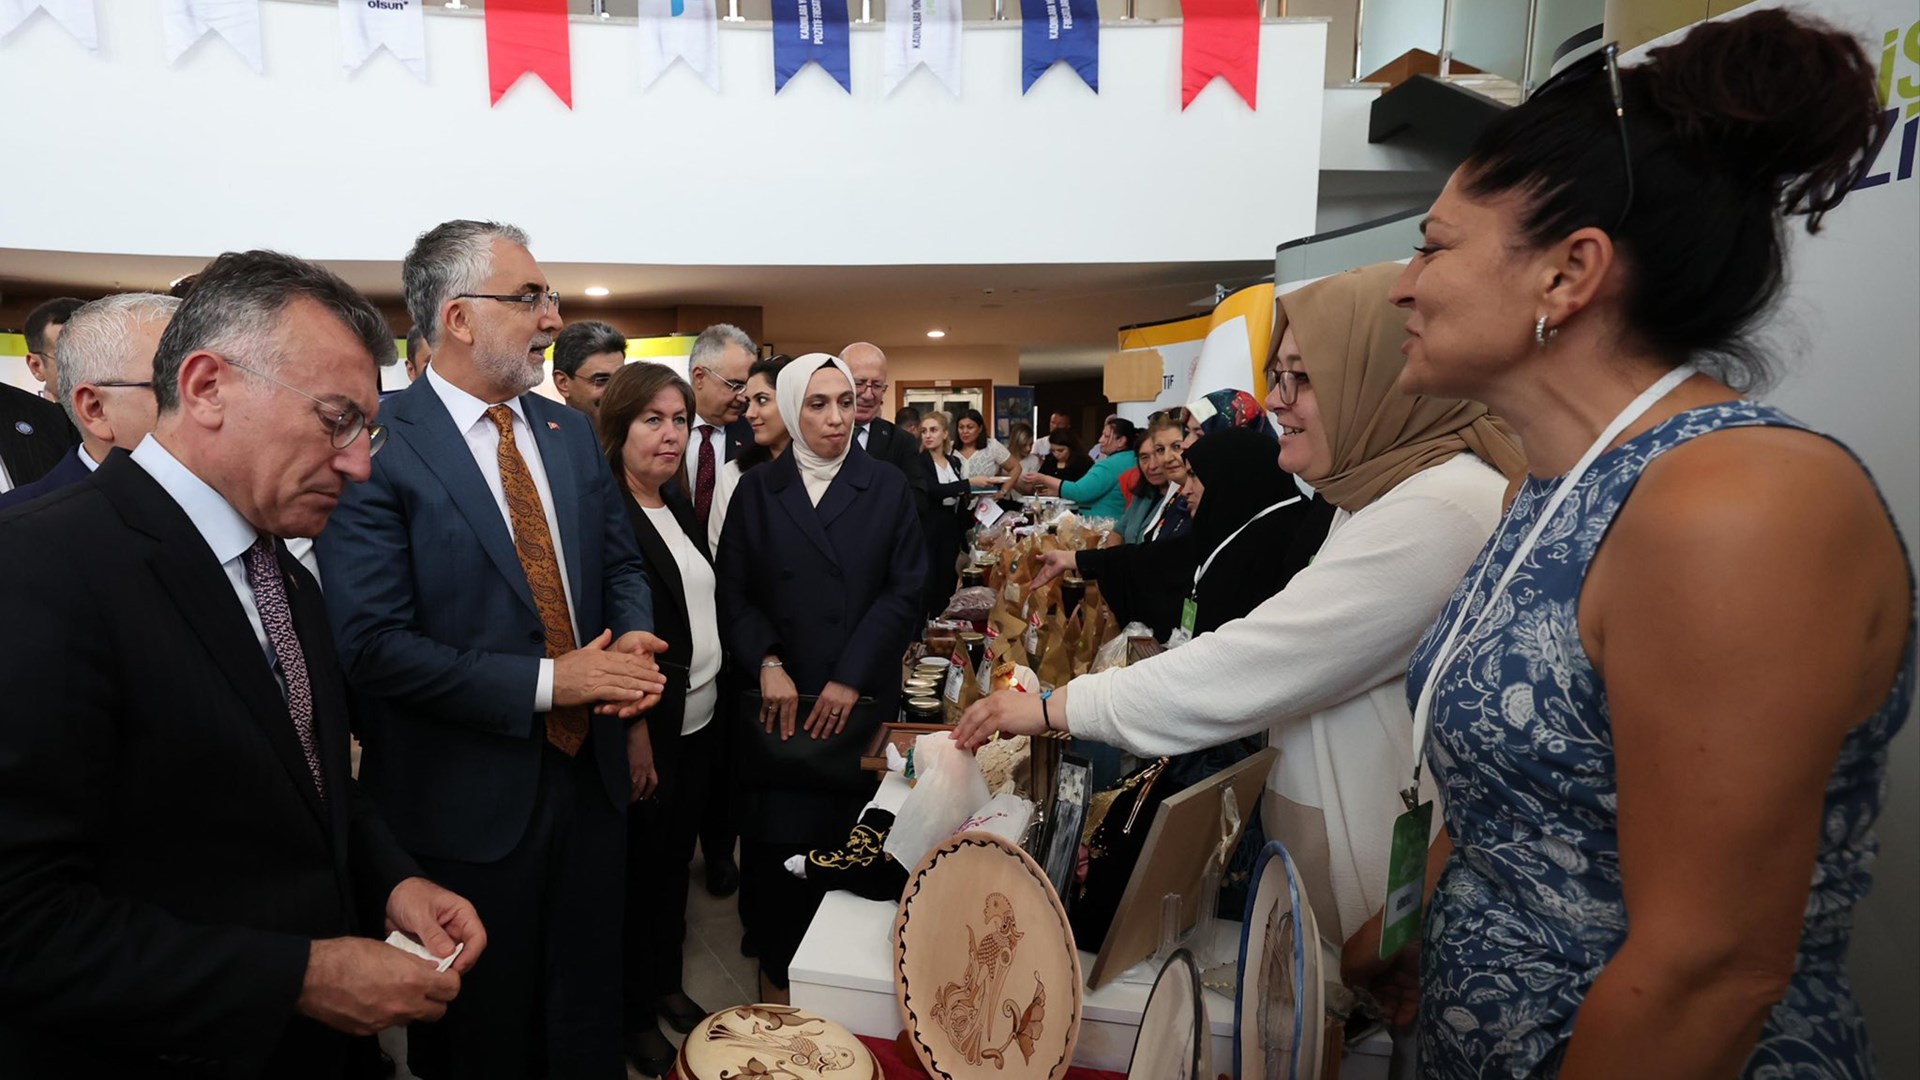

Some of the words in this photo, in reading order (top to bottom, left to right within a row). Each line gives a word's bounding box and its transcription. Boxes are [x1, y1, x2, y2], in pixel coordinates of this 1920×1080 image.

[798, 5, 810, 40] KADINLARA
[911, 12, 922, 49] KADINLARA
[1163, 374, 1175, 390] TİF
